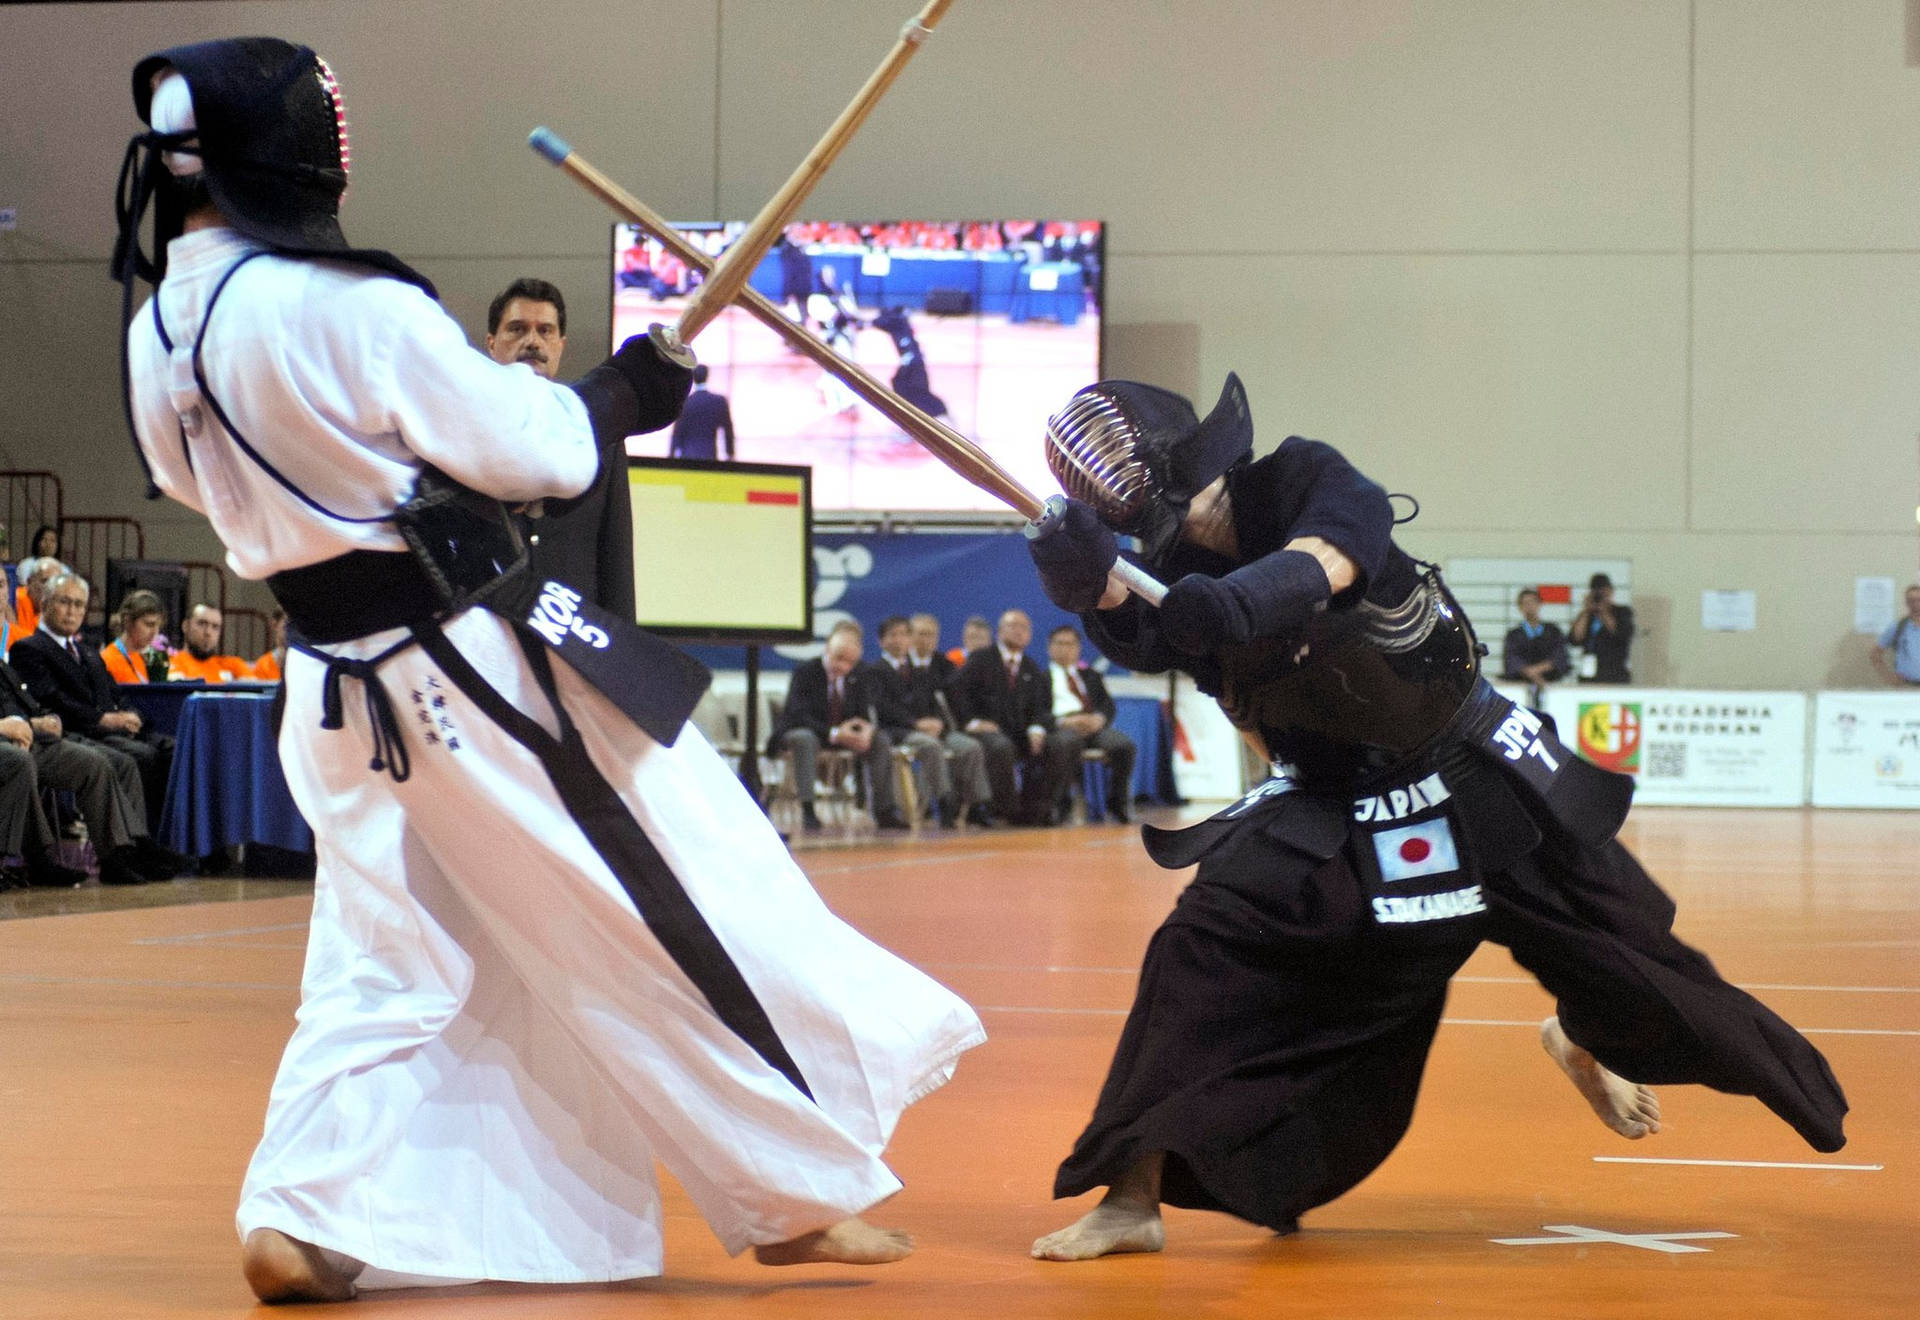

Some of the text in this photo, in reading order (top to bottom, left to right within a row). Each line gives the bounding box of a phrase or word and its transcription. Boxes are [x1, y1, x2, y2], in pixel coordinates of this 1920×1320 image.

[527, 580, 583, 646] KOR
[570, 615, 610, 649] 5
[1648, 704, 1772, 718] ACCADEMIA
[1657, 722, 1762, 735] KODOKAN
[1492, 702, 1543, 760] JPN
[1527, 737, 1560, 773] 7
[1354, 771, 1452, 822] JAPAN
